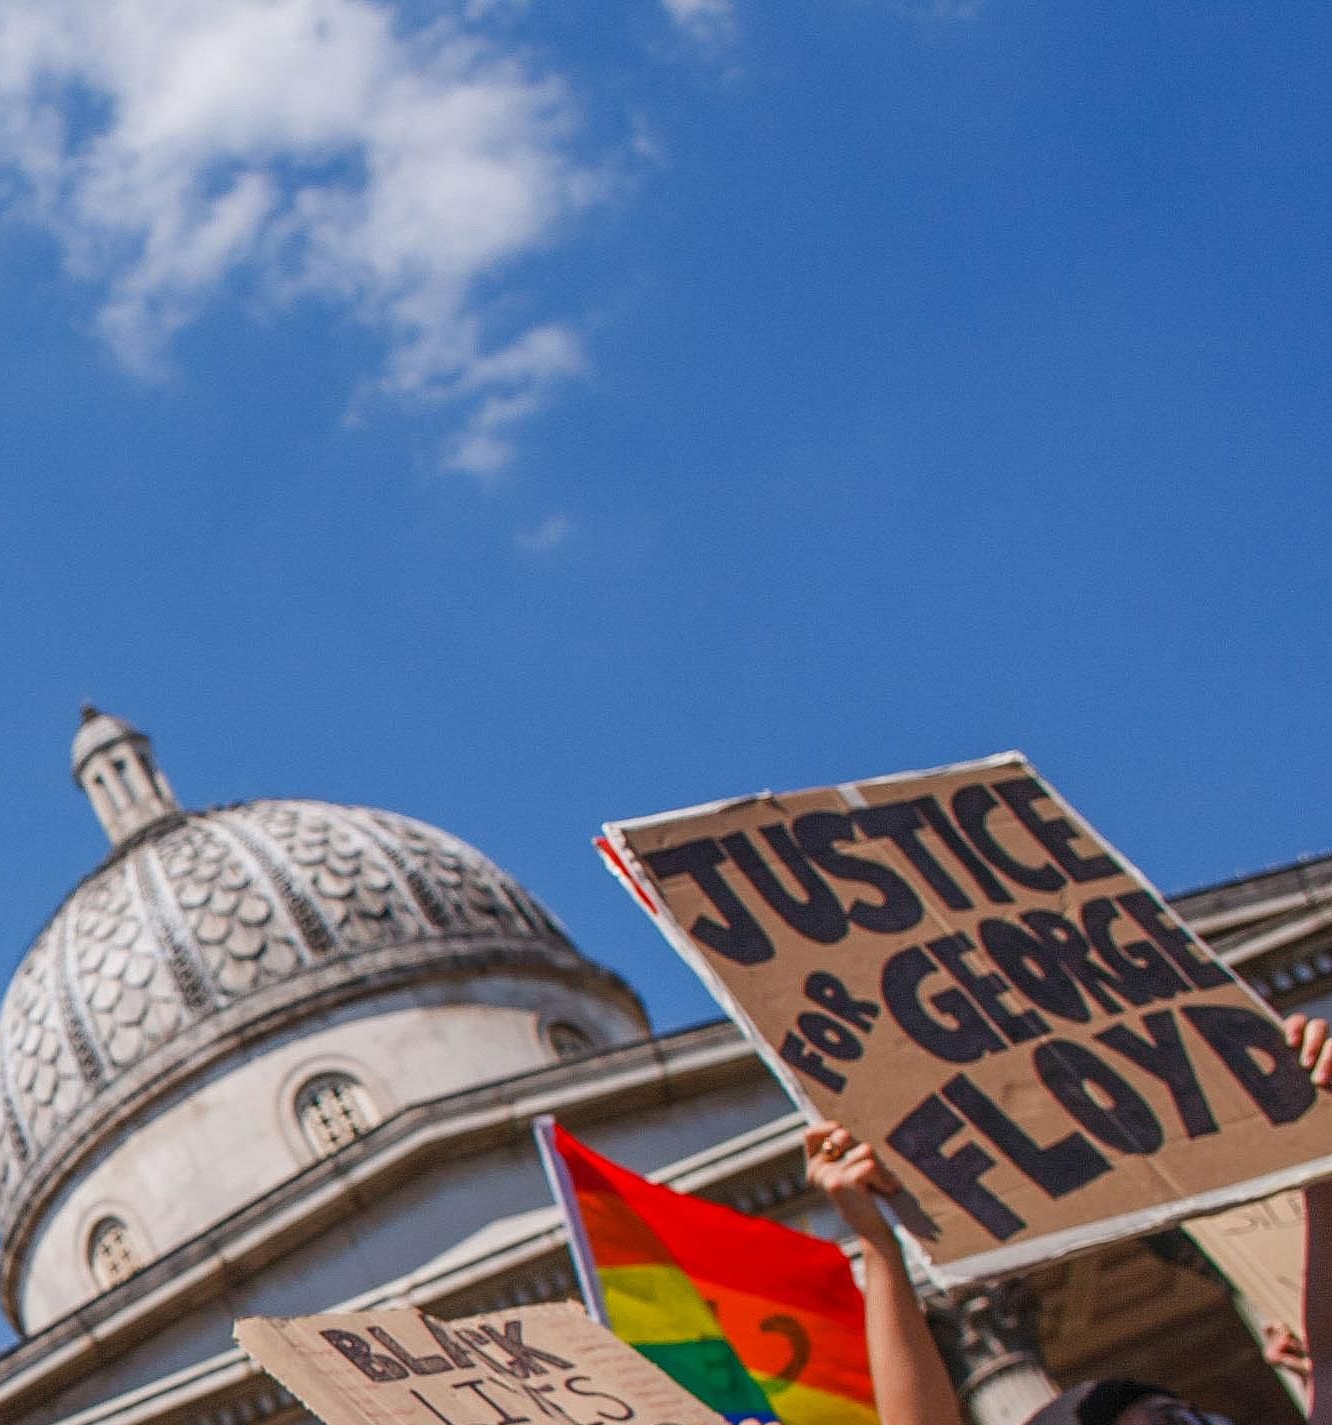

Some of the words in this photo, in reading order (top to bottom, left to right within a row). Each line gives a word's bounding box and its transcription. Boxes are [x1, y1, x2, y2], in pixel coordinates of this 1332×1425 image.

[643, 776, 1125, 966] JUSTICE
[779, 971, 881, 1094] FOR
[882, 891, 1236, 1064] GEORGE
[886, 1004, 1317, 1242] FLOYD
[319, 1309, 575, 1382] BLACK
